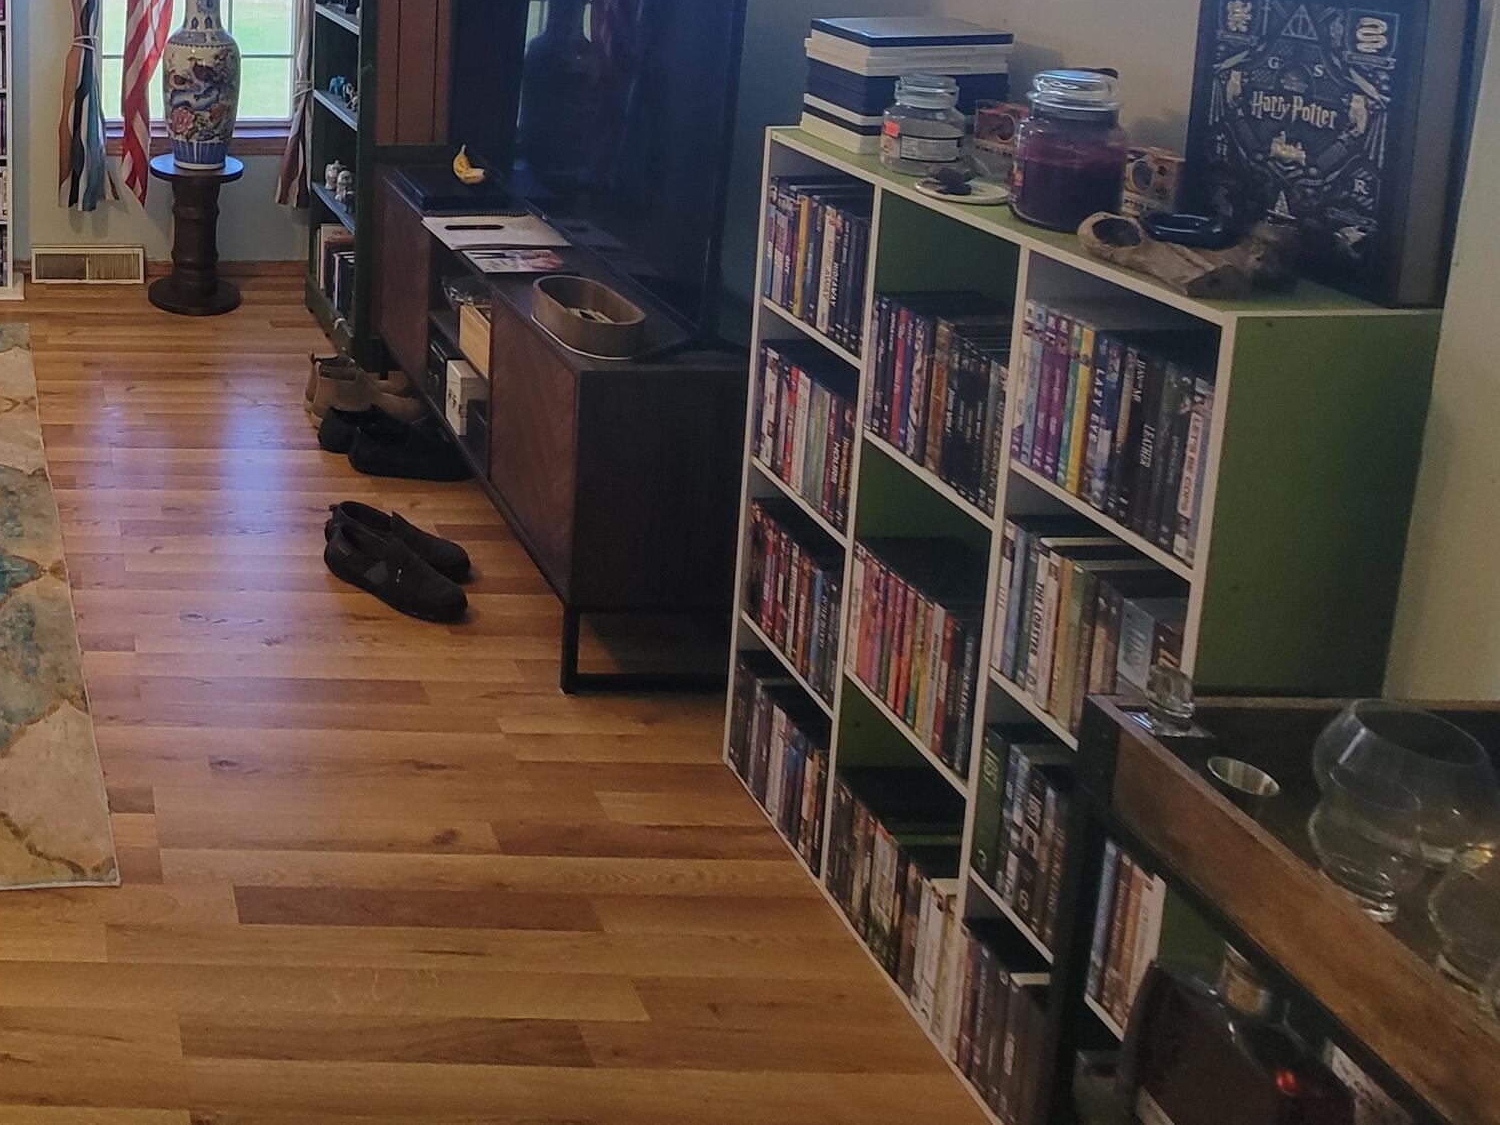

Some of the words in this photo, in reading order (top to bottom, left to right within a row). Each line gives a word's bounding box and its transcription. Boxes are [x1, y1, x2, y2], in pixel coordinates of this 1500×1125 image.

[1267, 56, 1280, 69] G
[1313, 63, 1324, 77] S
[1251, 91, 1292, 119] Harry
[1292, 95, 1338, 129] Potter
[1353, 179, 1369, 195] R
[830, 262, 840, 307] HIDEAWAY
[1092, 368, 1105, 408] LAZY
[1089, 413, 1100, 443] EYE
[1140, 423, 1156, 468] LEATHER
[1190, 415, 1202, 453] LET'S
[831, 441, 840, 484] HOURS
[1186, 455, 1196, 475] BE
[1180, 476, 1193, 513] COPS
[1034, 580, 1044, 604] THE
[1029, 605, 1042, 657] LOBSTER
[983, 748, 999, 791] LOST
[1027, 792, 1042, 832] LOST
